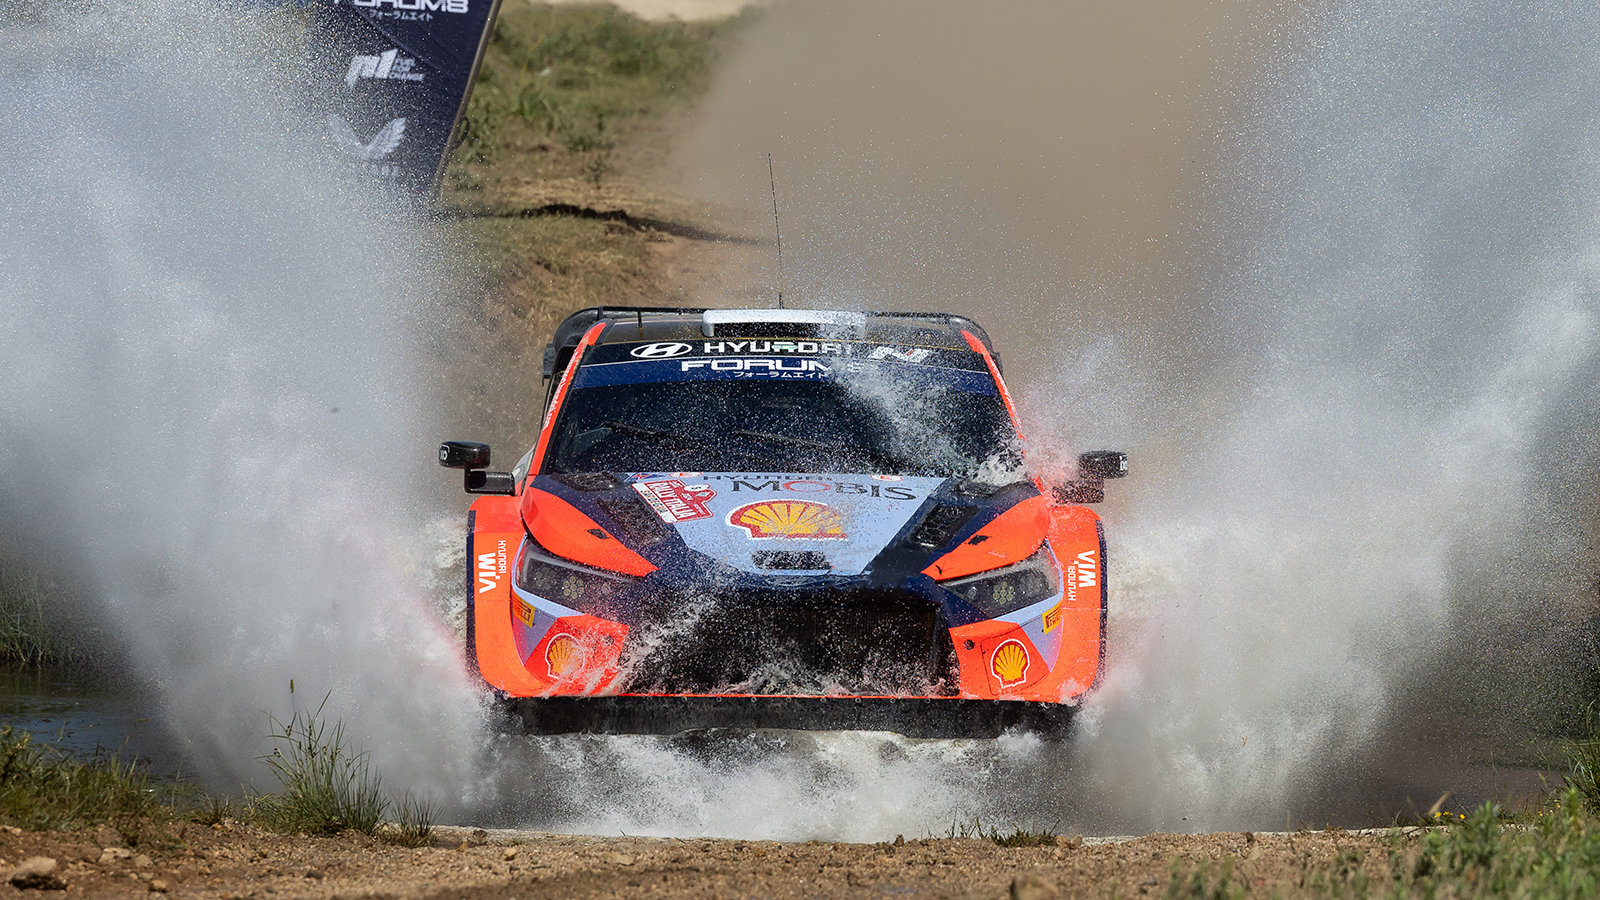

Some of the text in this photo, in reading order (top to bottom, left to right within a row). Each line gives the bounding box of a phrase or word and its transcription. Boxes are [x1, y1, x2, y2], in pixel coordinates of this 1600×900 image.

[334, 0, 468, 14] RUM8
[732, 480, 917, 501] MOBIS
[498, 540, 506, 574] HYUNDAI
[1068, 565, 1077, 601] HYUNDAI
